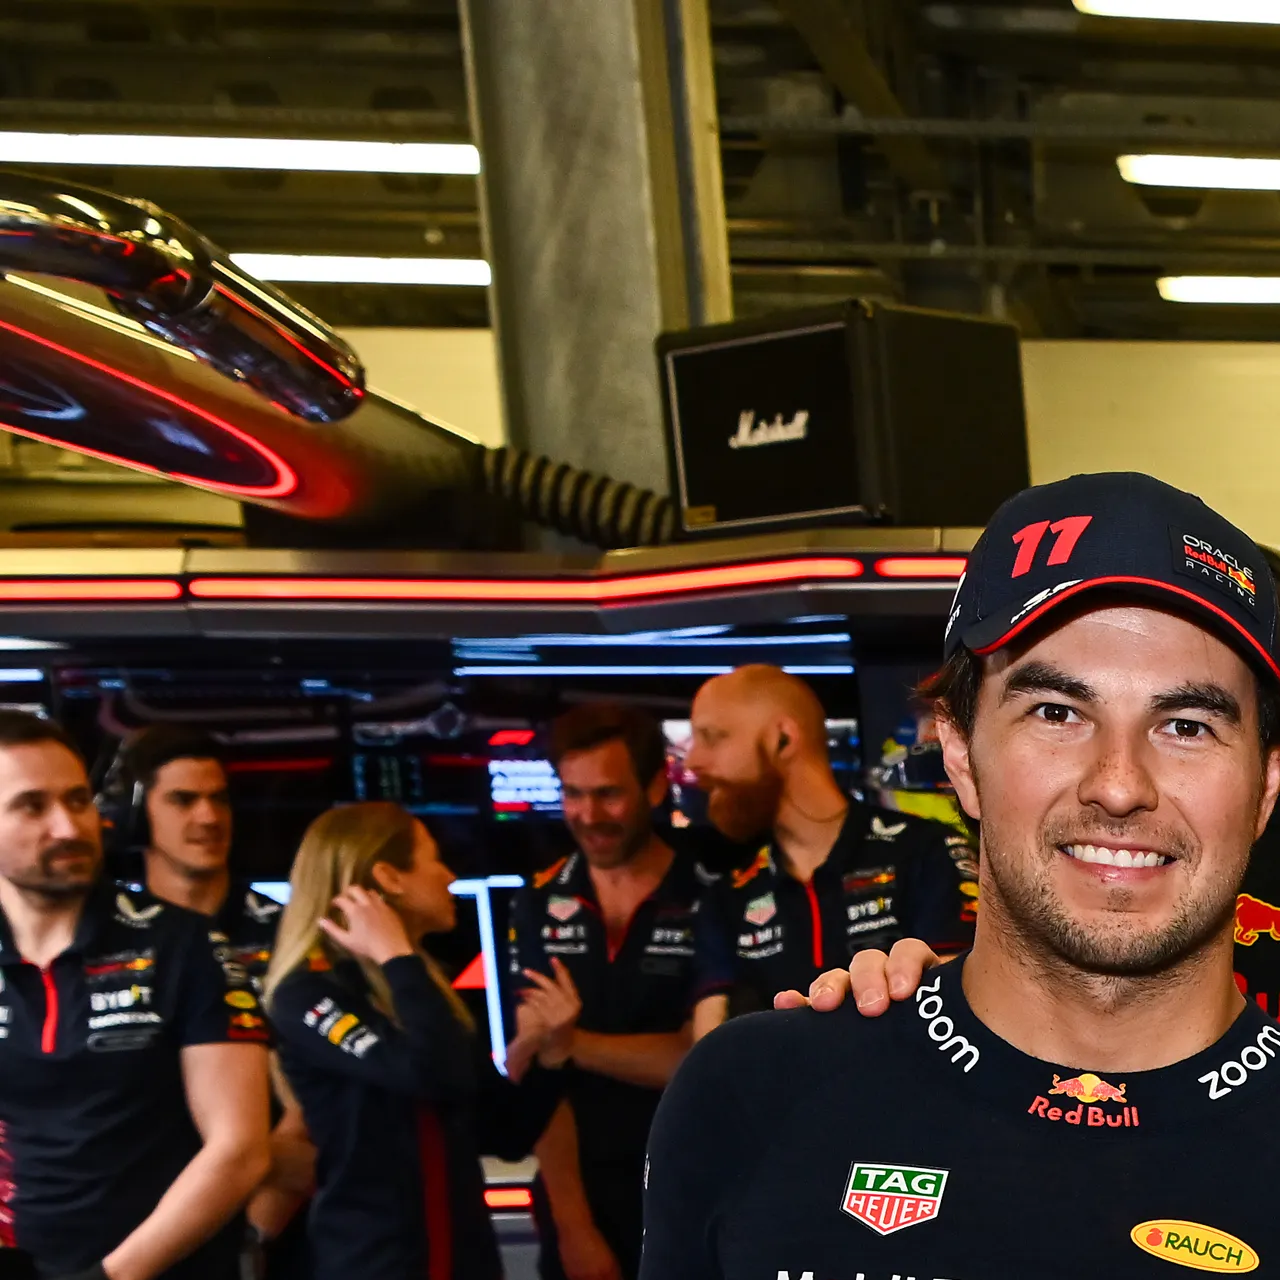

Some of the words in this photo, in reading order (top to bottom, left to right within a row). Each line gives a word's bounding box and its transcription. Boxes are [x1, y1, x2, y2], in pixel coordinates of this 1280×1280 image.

[1011, 515, 1093, 578] 11
[1182, 534, 1254, 581] ORACLE
[1183, 545, 1206, 562] Red
[1207, 557, 1228, 574] Bull
[1185, 560, 1256, 606] RACING
[916, 977, 979, 1072] zoom
[1028, 1094, 1081, 1125] Red
[1086, 1106, 1140, 1128] Bull
[860, 1168, 938, 1196] TAG
[849, 1194, 938, 1227] HEUER
[1164, 1231, 1243, 1267] RAUCH
